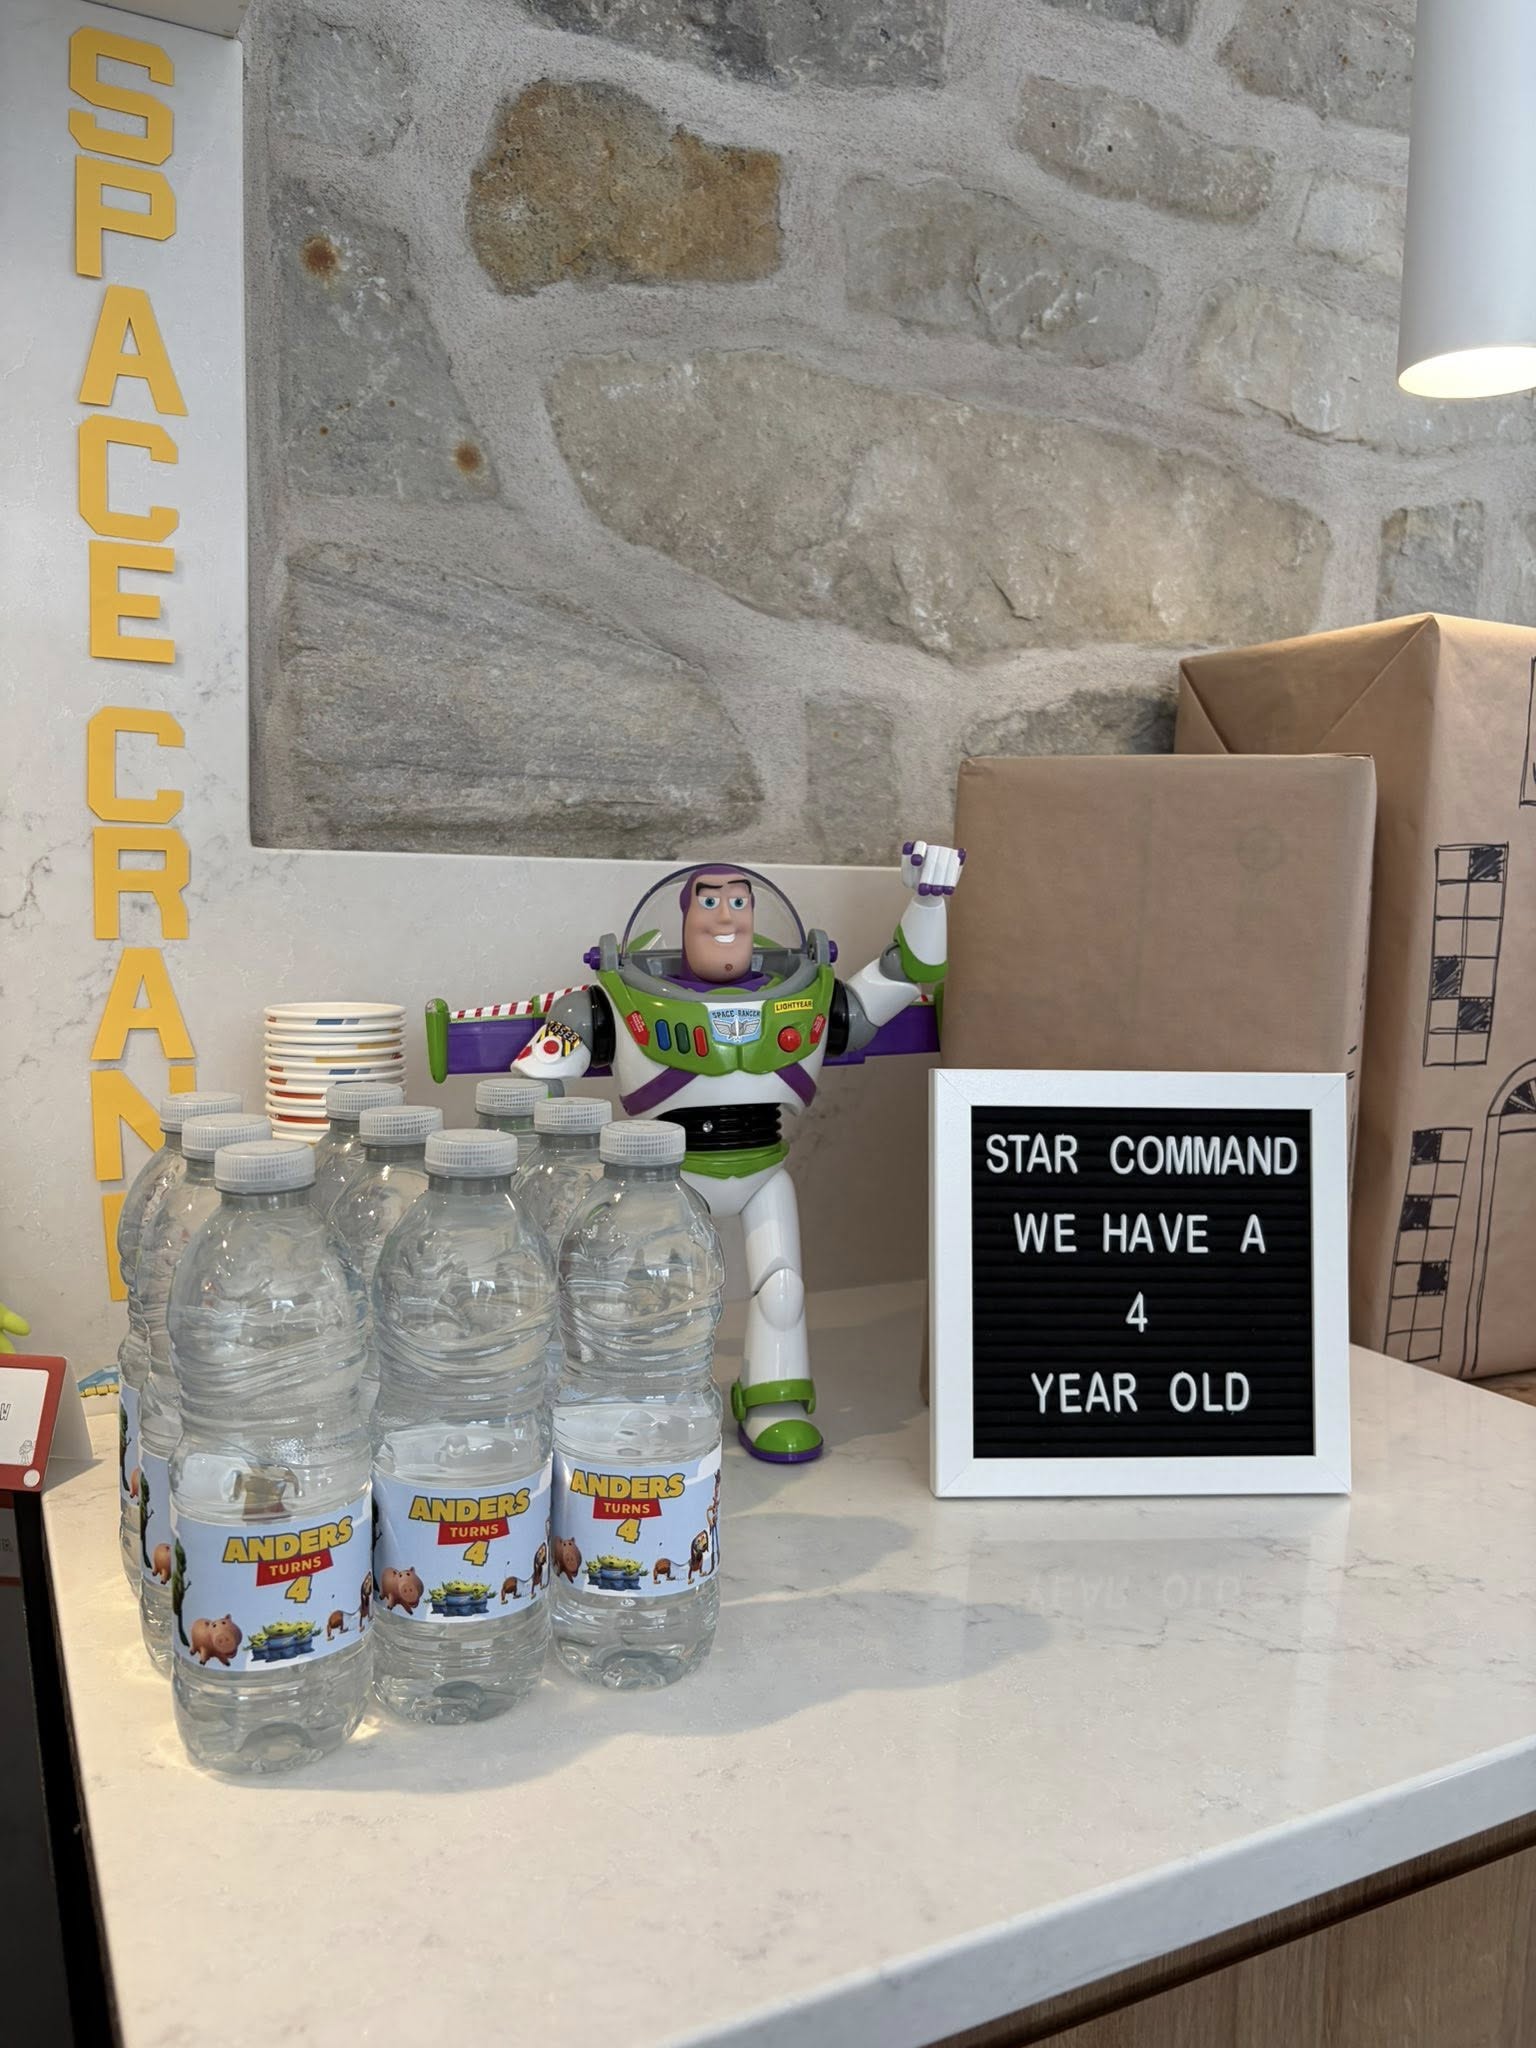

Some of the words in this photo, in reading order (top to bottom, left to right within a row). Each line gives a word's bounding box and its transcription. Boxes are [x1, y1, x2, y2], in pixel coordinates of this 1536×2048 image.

[68, 25, 188, 664] SPACE
[712, 1009, 735, 1019] SPACE
[776, 1000, 812, 1012] LIGHTYEAR
[986, 1132, 1078, 1174] STAR
[1109, 1135, 1298, 1176] COMMAND
[1013, 1212, 1077, 1254] WE
[1102, 1213, 1209, 1254] HAVE
[1239, 1214, 1266, 1254] A
[1125, 1291, 1149, 1333] 4
[1030, 1371, 1138, 1414] YEAR
[1169, 1371, 1250, 1413] OLD
[570, 1469, 686, 1499] ANDERS
[408, 1488, 532, 1523] ANDERS
[603, 1501, 651, 1515] TURNS
[221, 1515, 354, 1564] ANDERS
[450, 1523, 499, 1539] TURNS
[616, 1518, 642, 1544] 4
[268, 1556, 323, 1577] TURNS
[463, 1540, 490, 1567] 4
[284, 1574, 313, 1604] 4
